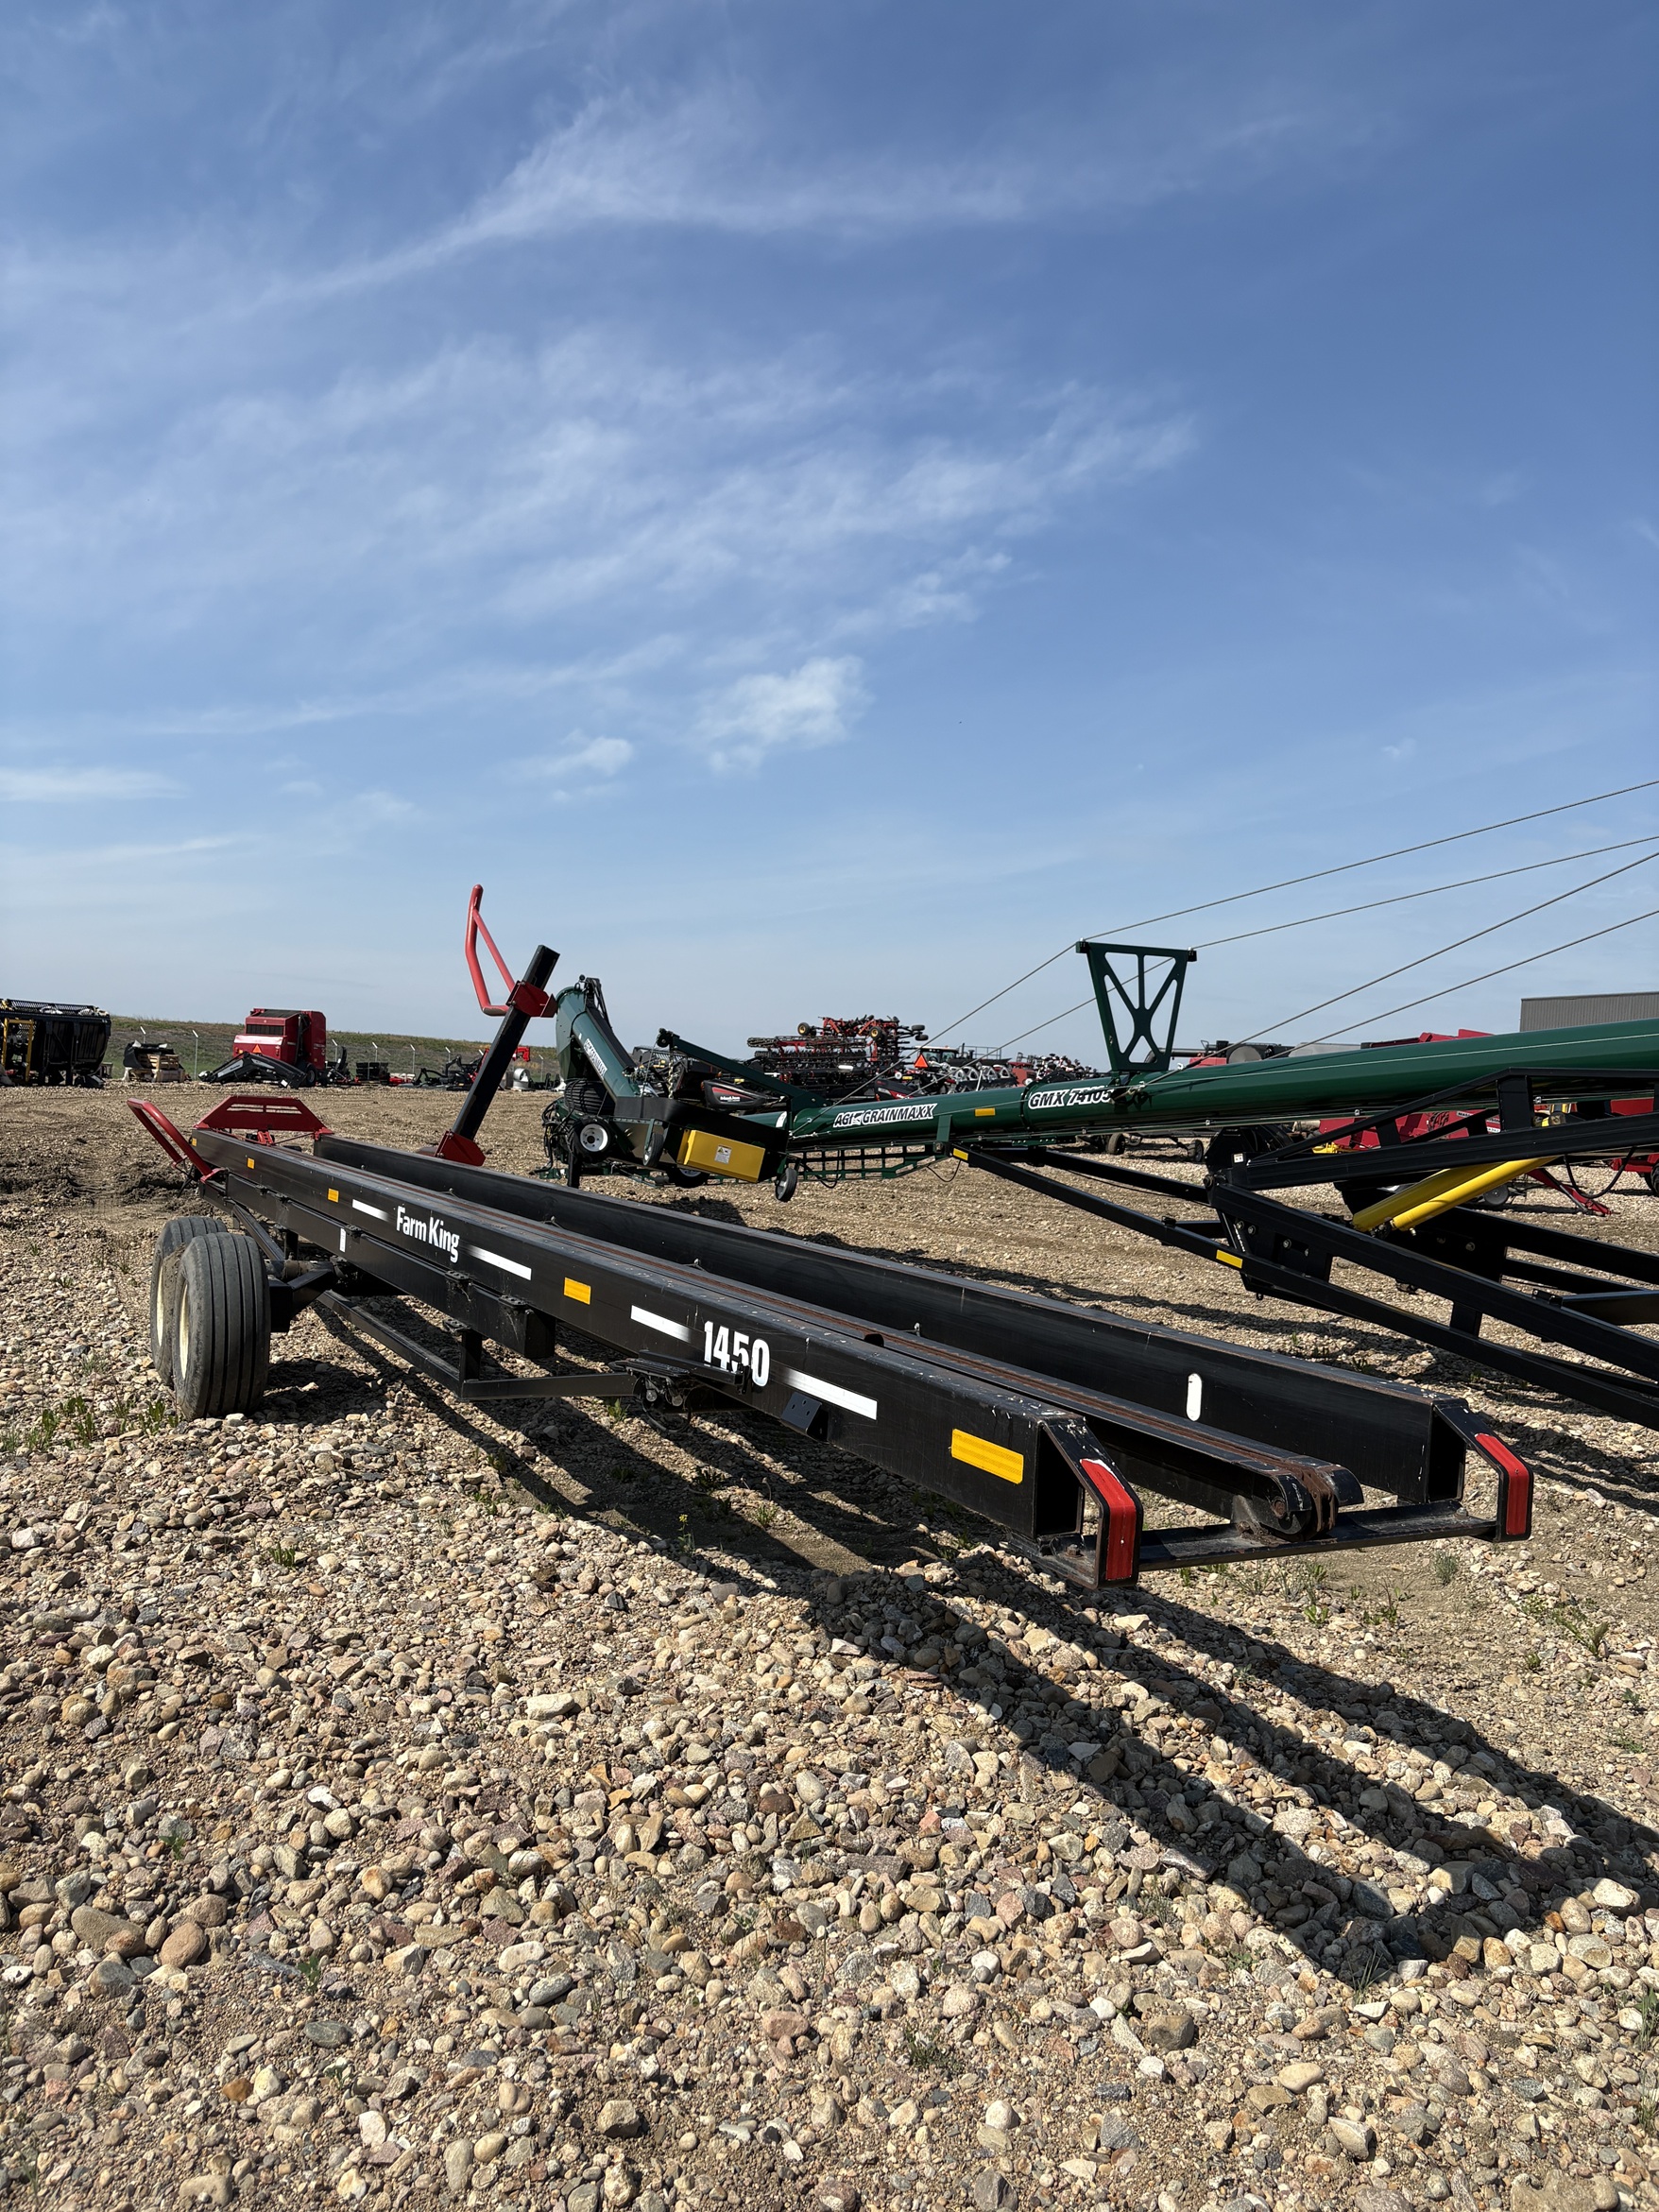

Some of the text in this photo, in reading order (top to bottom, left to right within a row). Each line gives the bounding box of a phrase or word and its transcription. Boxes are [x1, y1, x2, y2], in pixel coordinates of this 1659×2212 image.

[833, 1104, 937, 1127] AGI GRAINMAXX
[1029, 1089, 1069, 1109] GMX
[397, 1205, 460, 1263] Farm King
[704, 1320, 770, 1387] 1450
